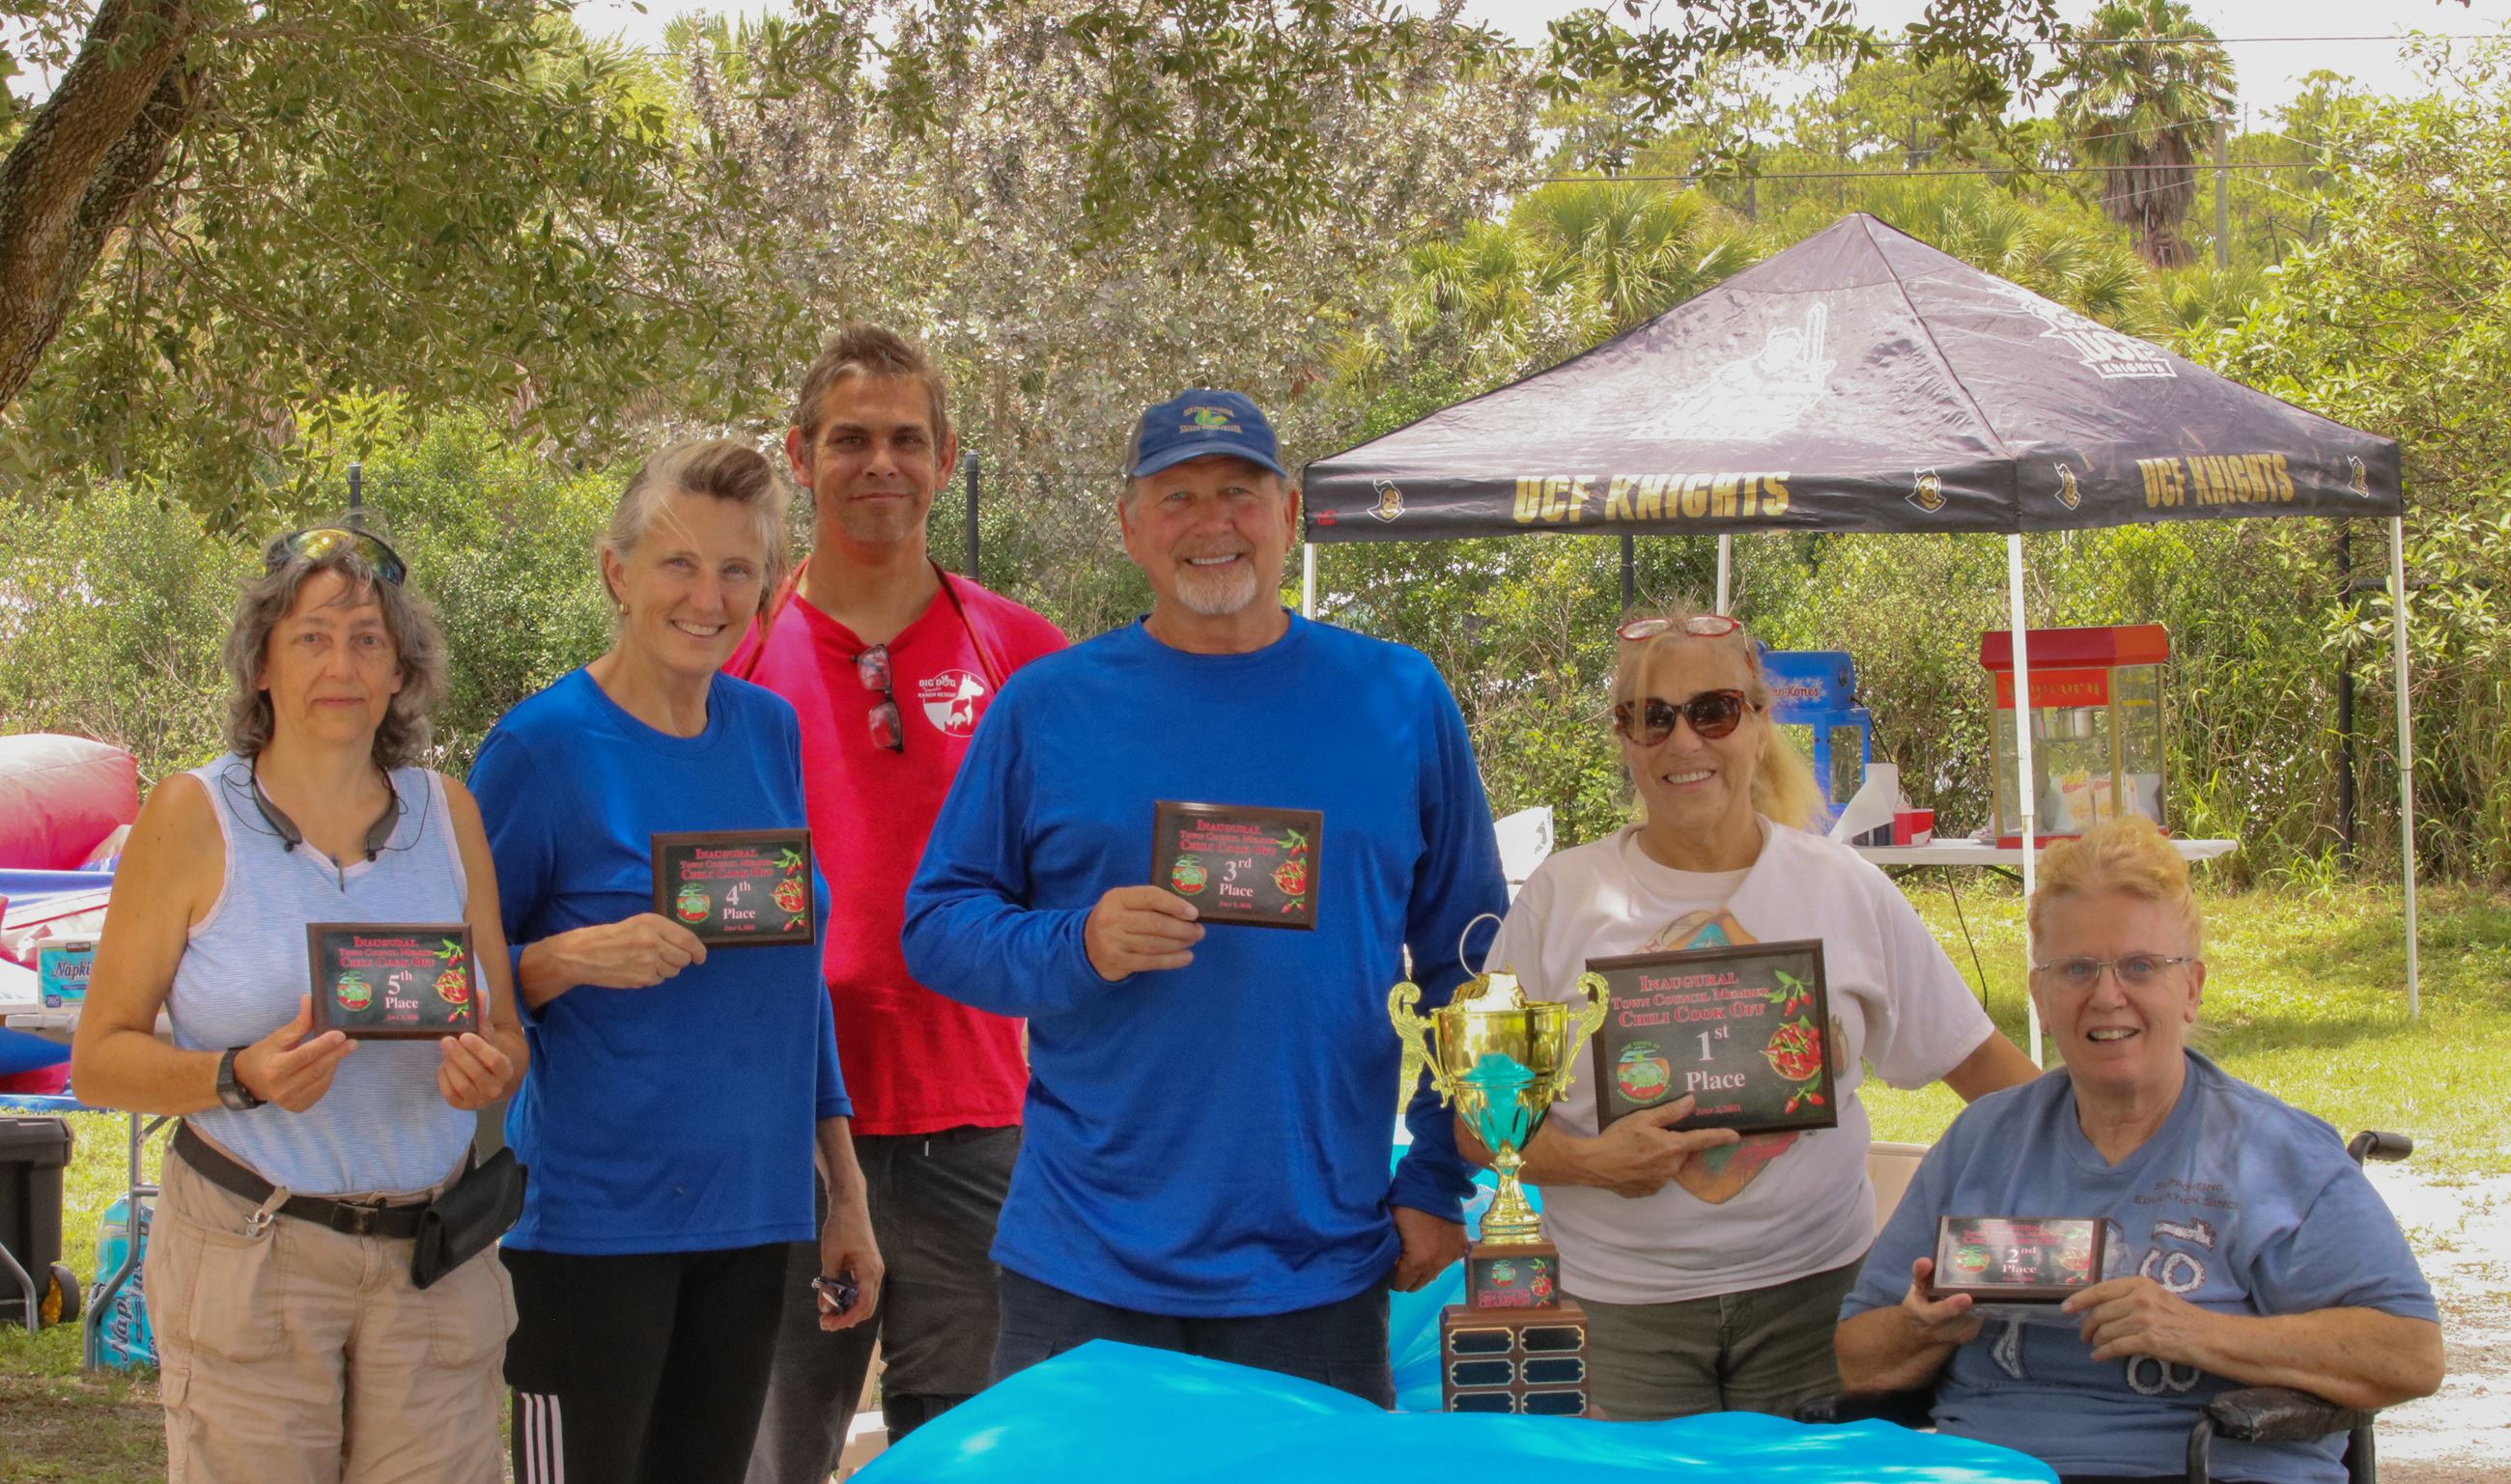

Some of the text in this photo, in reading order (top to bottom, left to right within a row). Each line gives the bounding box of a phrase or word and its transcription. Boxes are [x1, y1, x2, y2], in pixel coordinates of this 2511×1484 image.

[2135, 453, 2295, 508] UCF KNIGHTS
[1512, 470, 1791, 523] UCF KNIGHTS
[918, 676, 957, 687] BIG DOG
[1223, 857, 1253, 882] 3rd
[725, 880, 751, 906] 4th
[1219, 882, 1255, 898] Place
[722, 908, 756, 920] Place
[51, 959, 93, 983] Napki
[387, 969, 413, 995] 5th
[1639, 972, 1739, 993] INAUGURAL
[384, 996, 419, 1010] Place
[1611, 987, 1770, 1011] TOWN COUNCIL MEMBER
[1618, 1001, 1766, 1028] CHILI COOK OFF
[1696, 1023, 1730, 1063] 1st
[1684, 1072, 1747, 1093] Place
[2006, 1246, 2037, 1264] 2nd
[2002, 1264, 2038, 1274] Place
